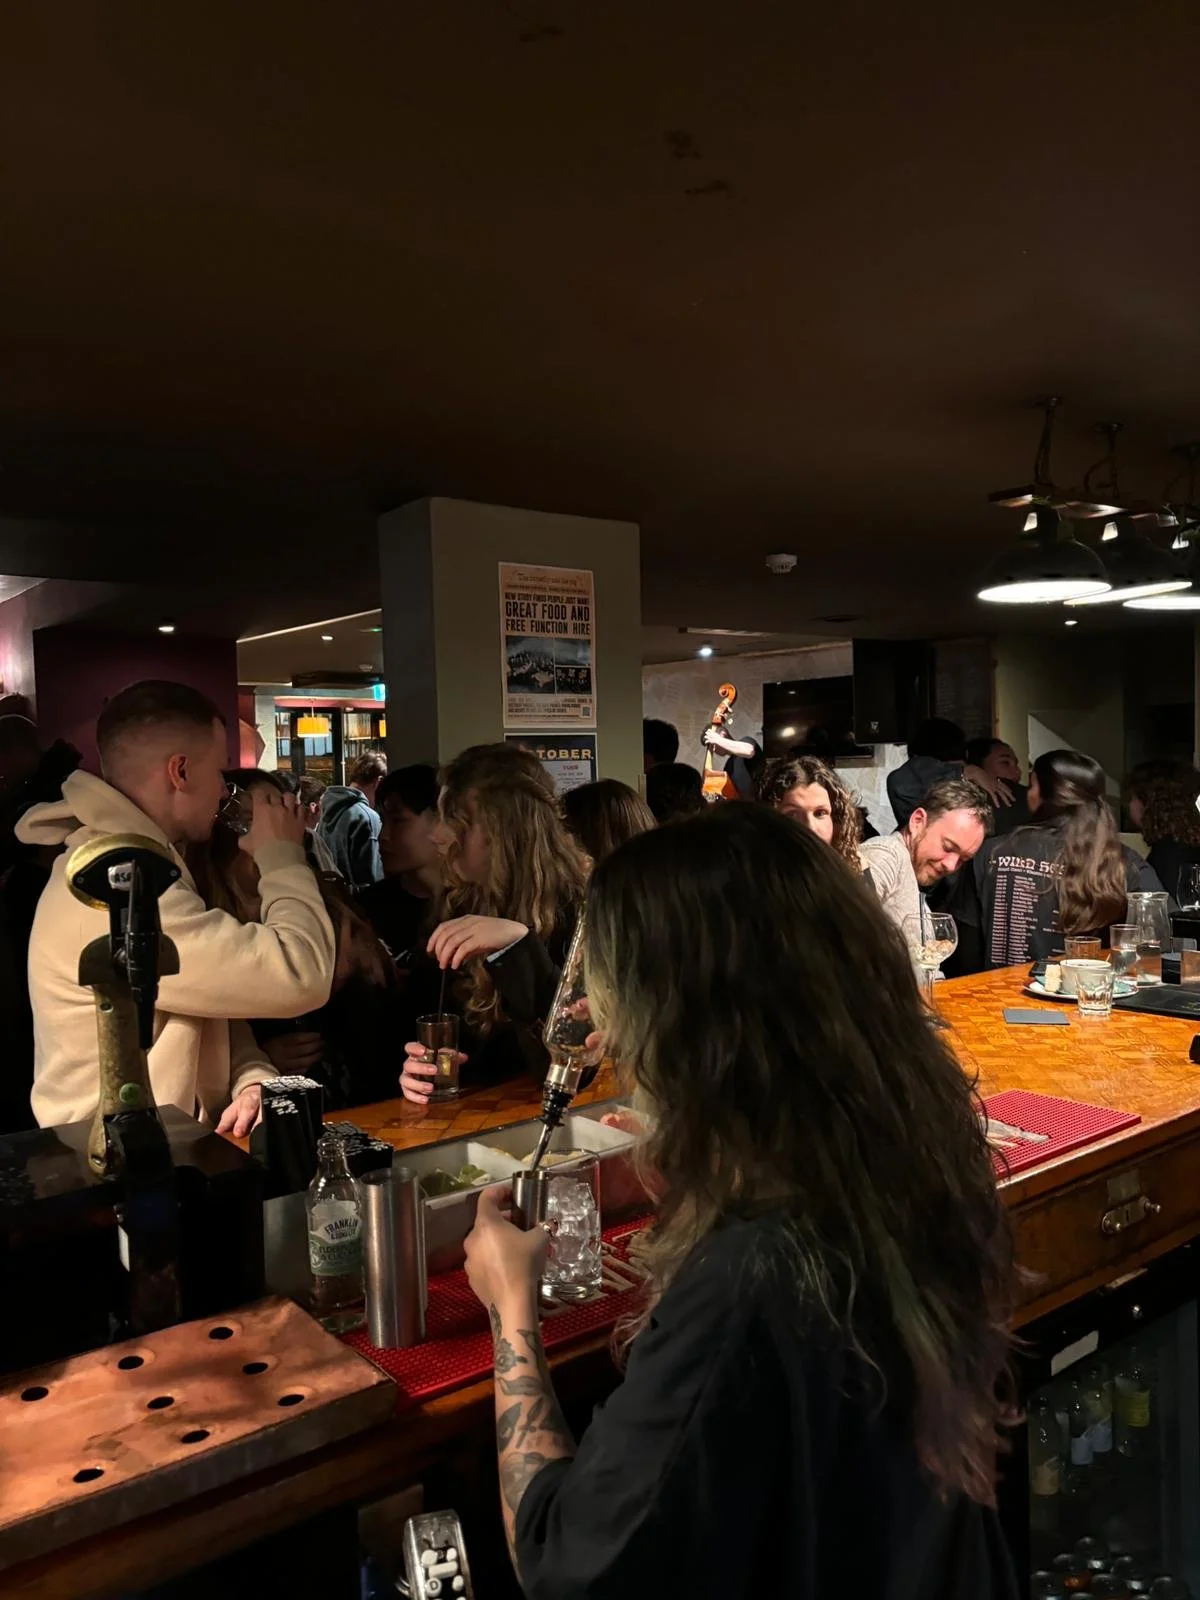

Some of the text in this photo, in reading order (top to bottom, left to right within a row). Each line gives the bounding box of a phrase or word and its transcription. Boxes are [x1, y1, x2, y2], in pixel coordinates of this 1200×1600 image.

[505, 592, 516, 600] NEW
[565, 596, 576, 604] JUST
[505, 601, 590, 621] GREAT FOOD AND
[506, 619, 590, 635] FREE FUNCTION HIRE
[536, 748, 592, 760] TOBER
[324, 1218, 358, 1235] FRANKLIN
